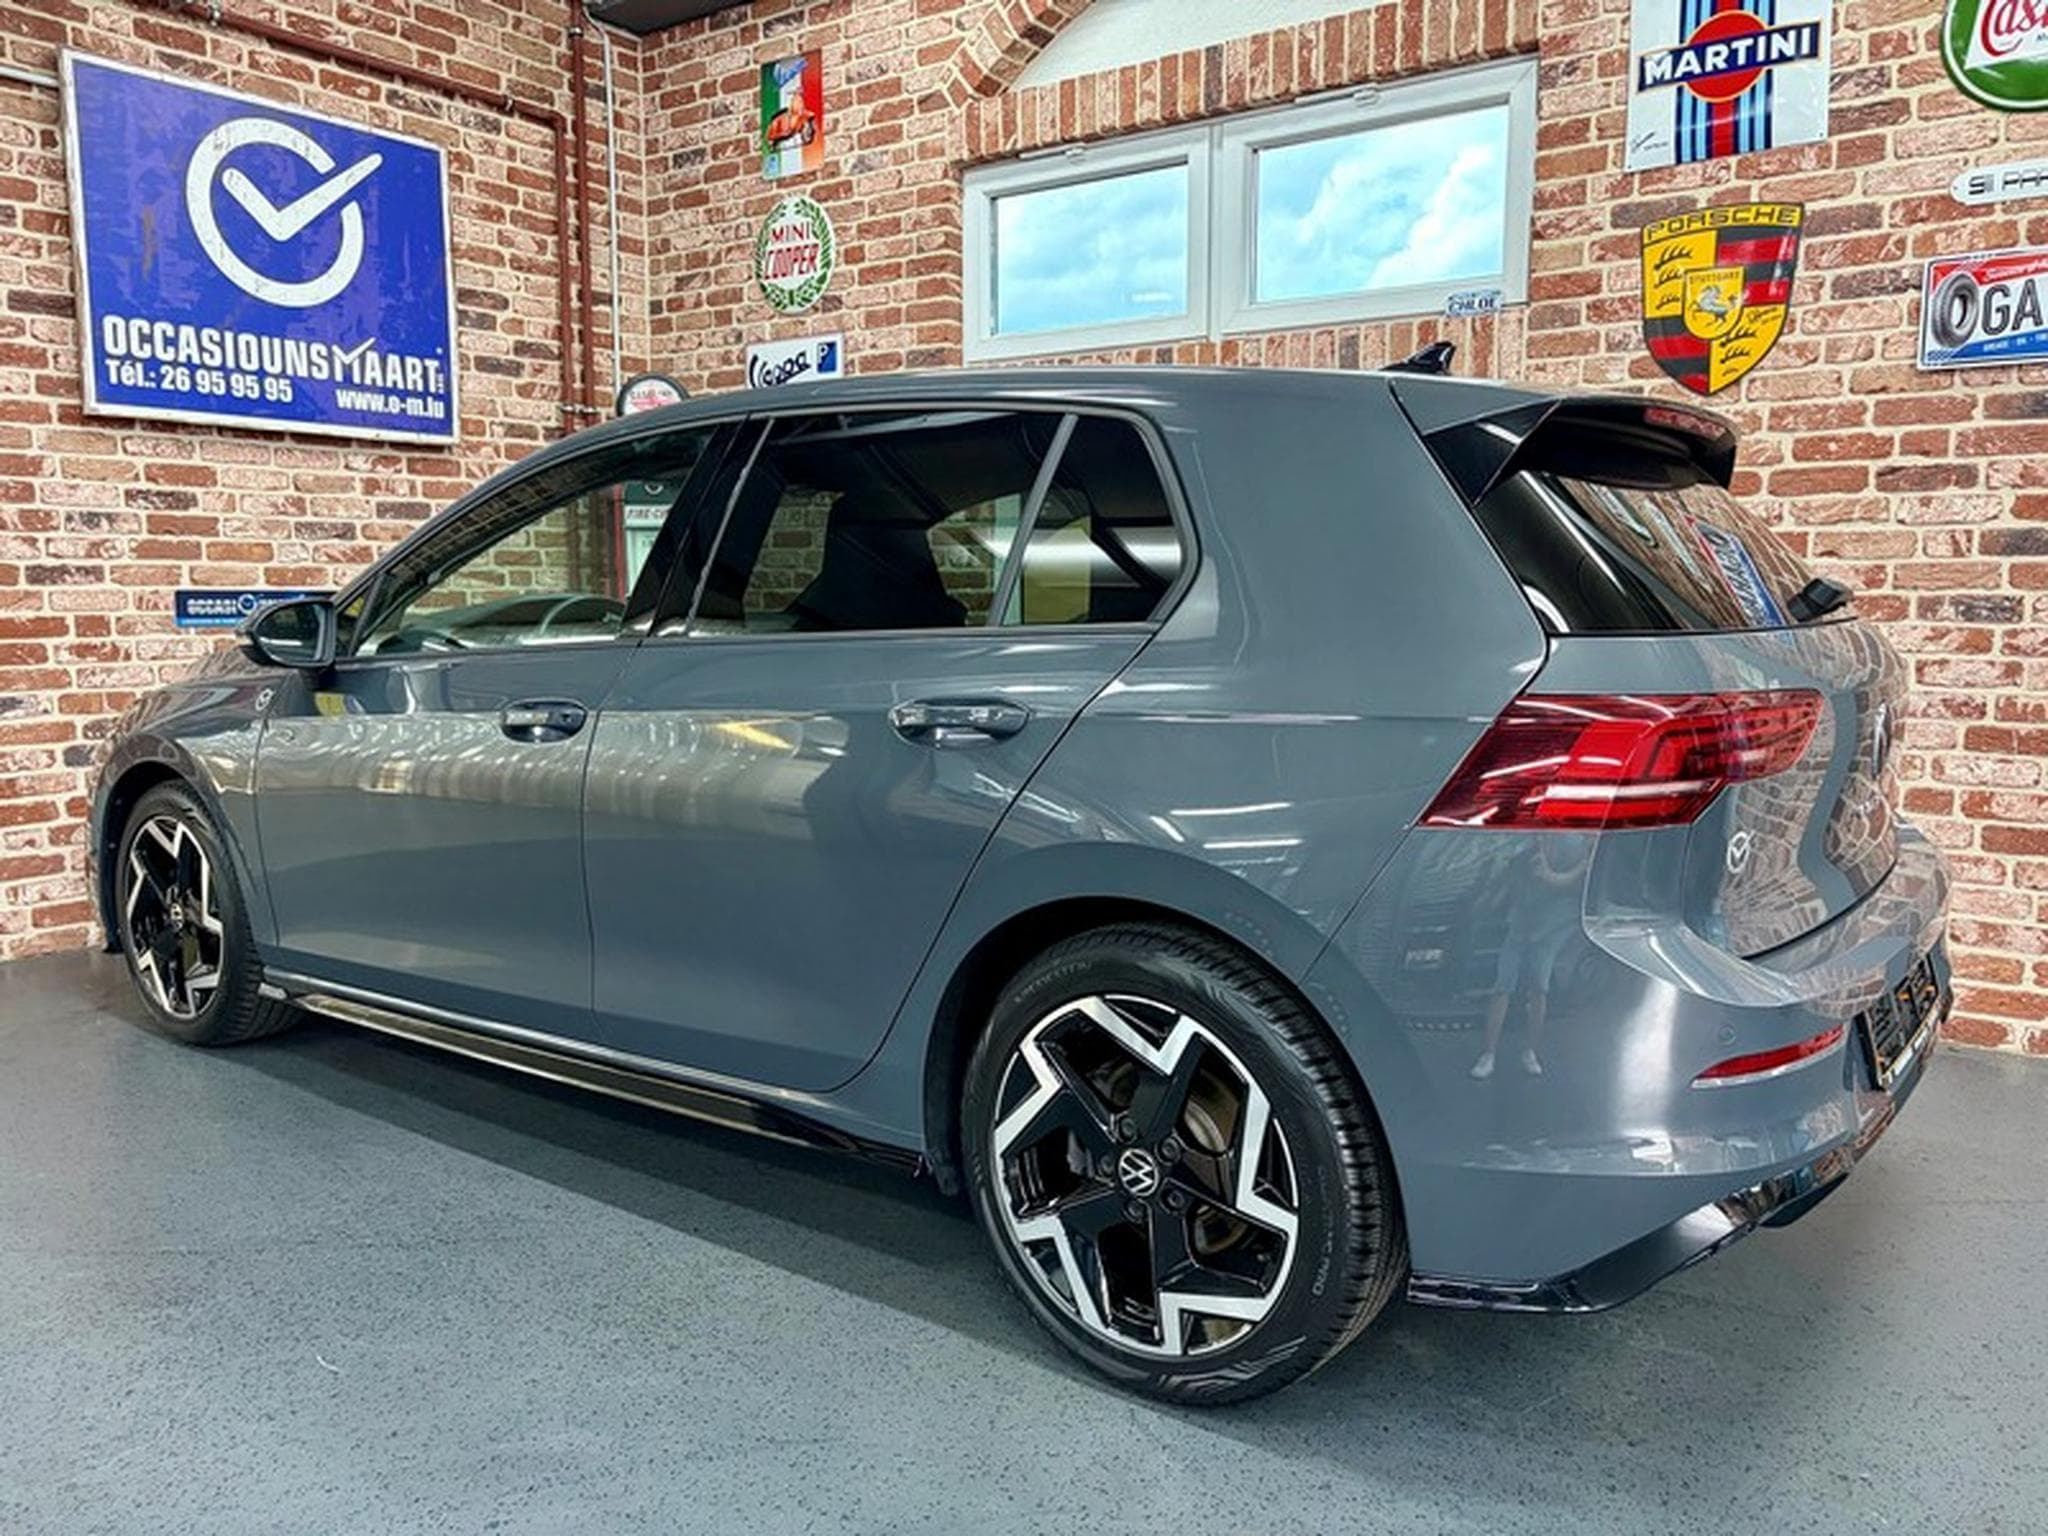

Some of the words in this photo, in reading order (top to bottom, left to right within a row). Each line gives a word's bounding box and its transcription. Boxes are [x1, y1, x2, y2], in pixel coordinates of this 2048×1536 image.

[1981, 0, 2048, 57] Cas
[1643, 27, 1812, 86] MARTINI
[772, 222, 811, 243] MINI
[1647, 206, 1797, 240] PORSCHE
[764, 243, 819, 280] COOPER
[104, 358, 157, 388] Tél.:
[160, 365, 191, 392] 26
[195, 369, 226, 396] 95
[230, 373, 260, 400] 95
[263, 376, 293, 403] 95
[335, 389, 445, 419] www.o-m.lu
